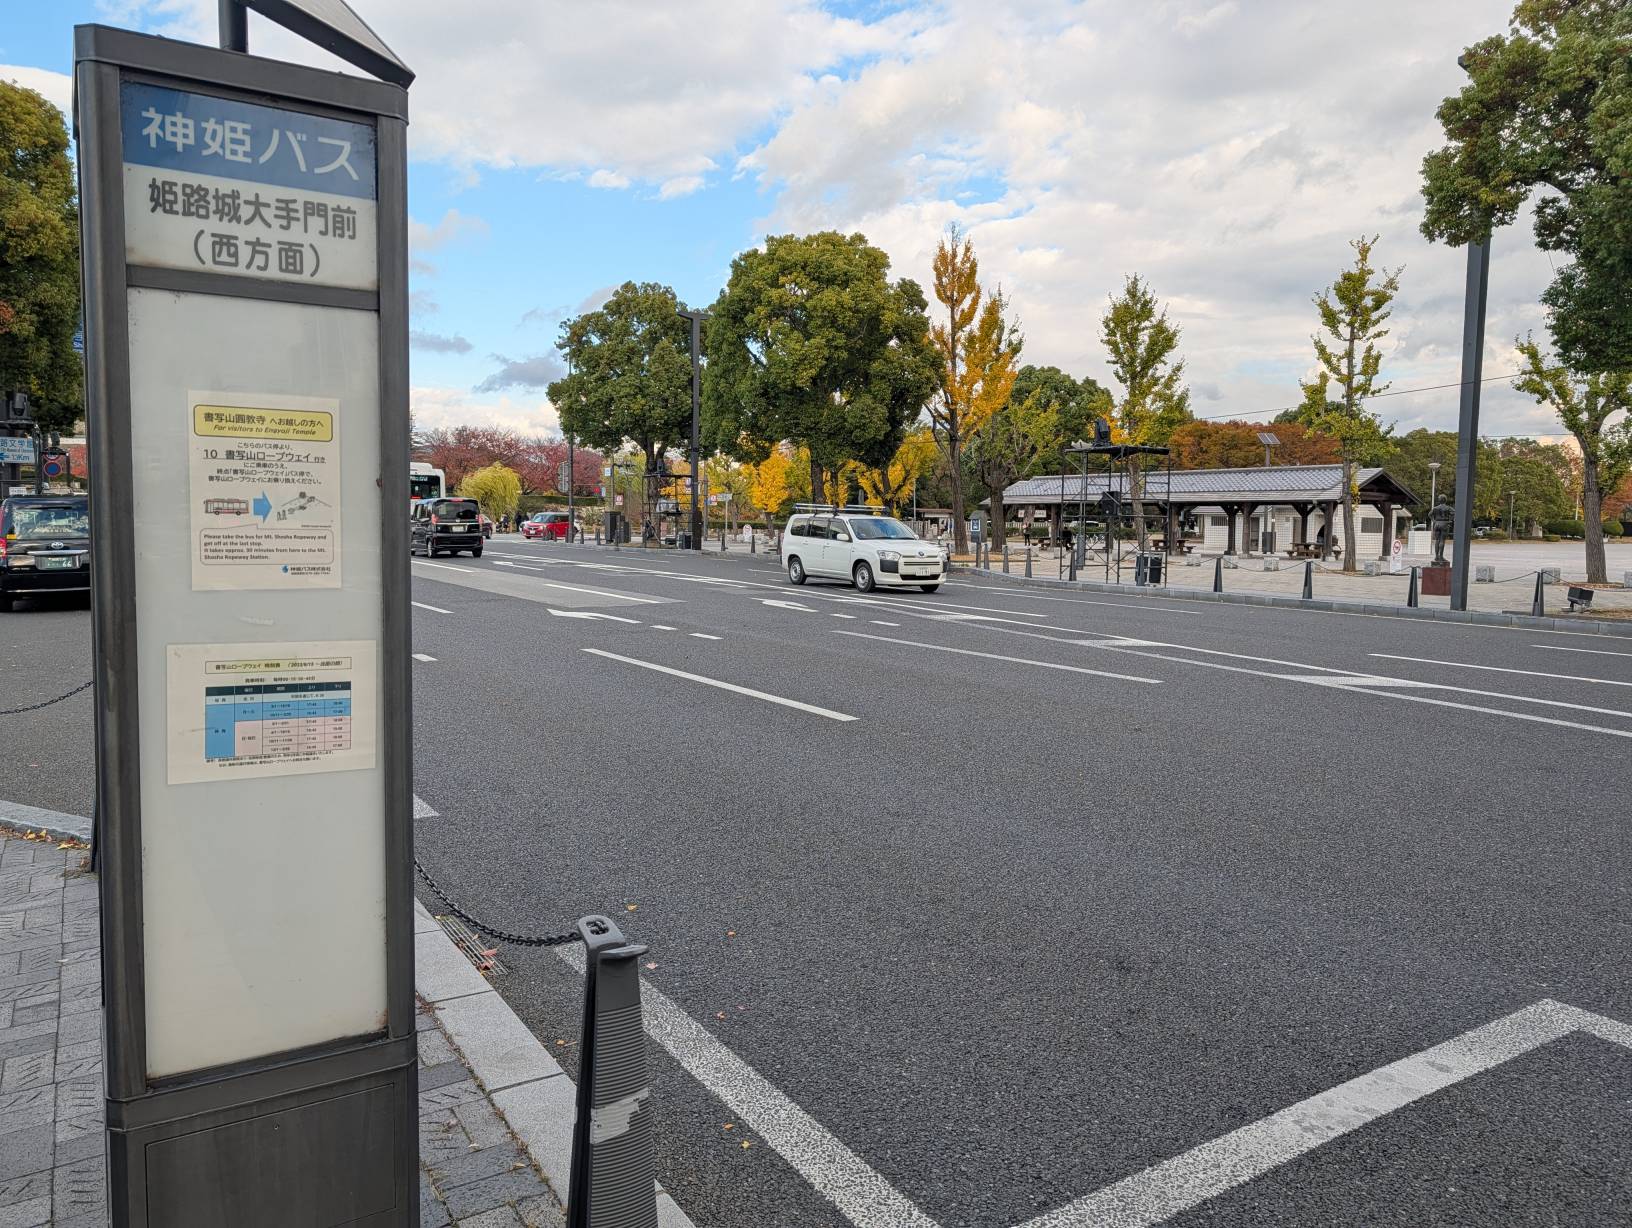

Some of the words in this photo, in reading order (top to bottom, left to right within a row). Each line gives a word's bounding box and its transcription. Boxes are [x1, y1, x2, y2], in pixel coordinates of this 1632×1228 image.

[141, 106, 360, 181] 神姫バス
[148, 177, 357, 241] 姫路城大手門前
[193, 228, 320, 278] （西方面）
[203, 449, 218, 459] 10
[225, 449, 311, 462] 書写山ロープウェイ
